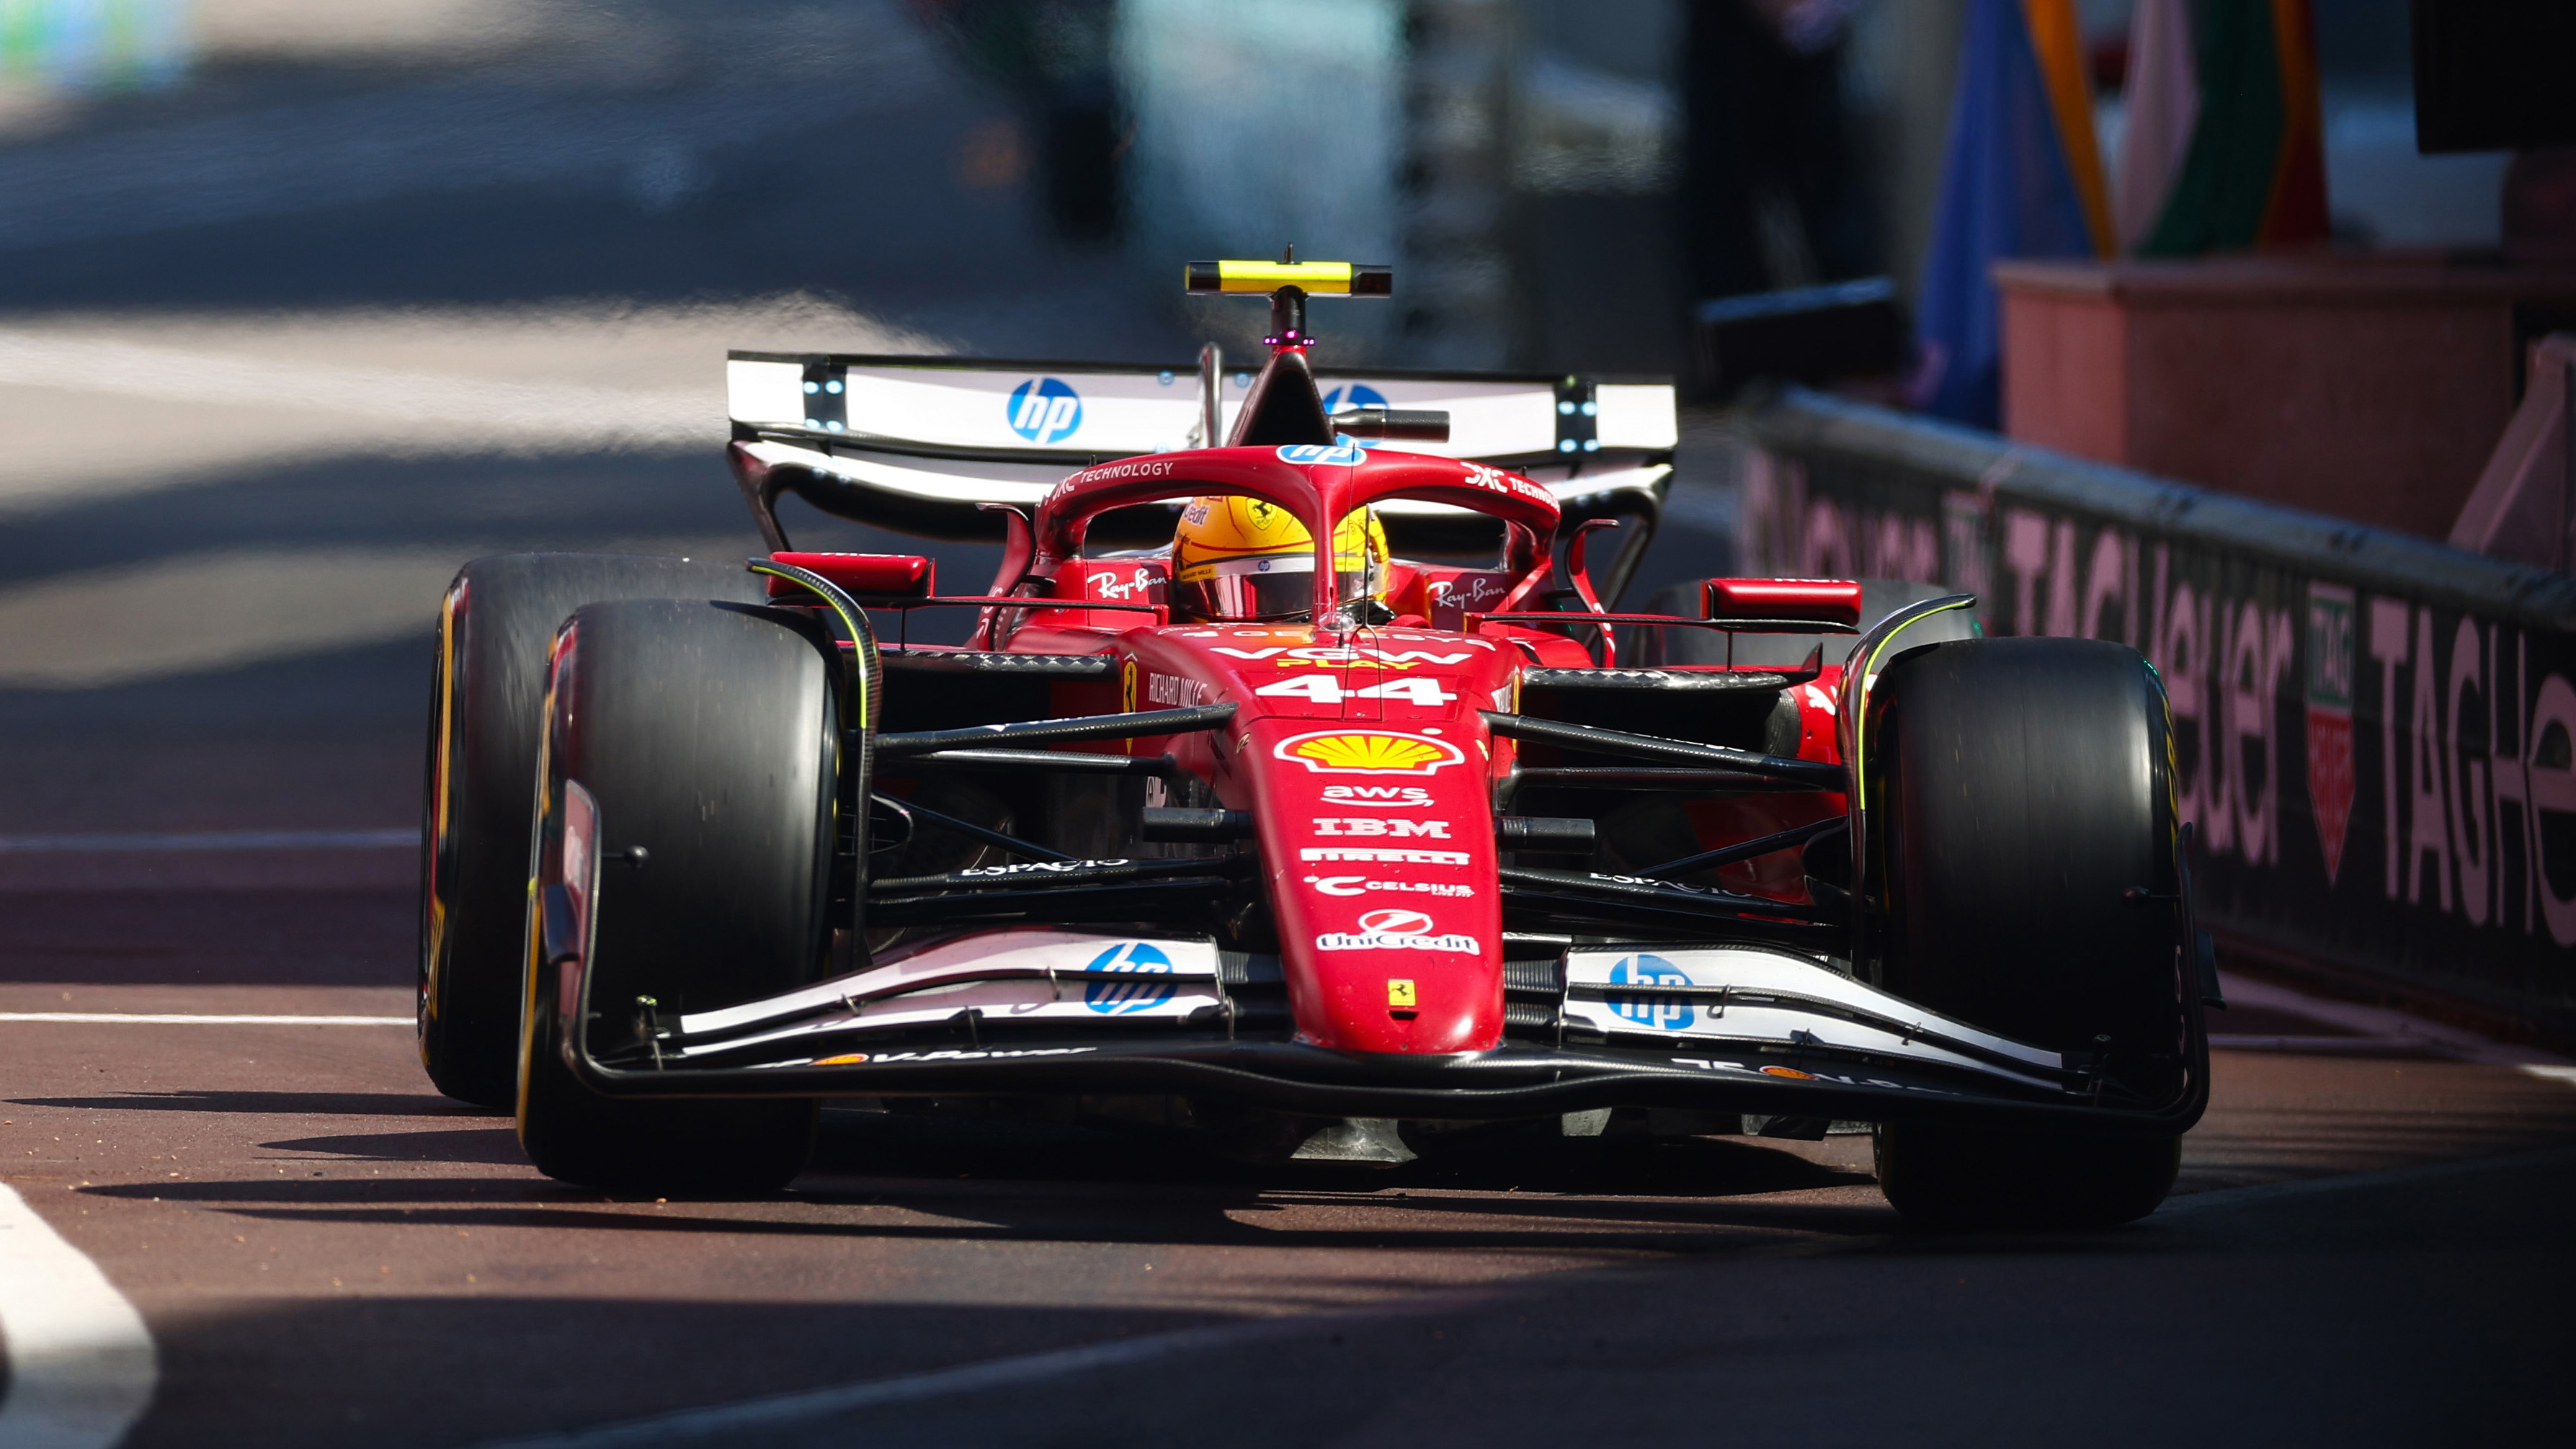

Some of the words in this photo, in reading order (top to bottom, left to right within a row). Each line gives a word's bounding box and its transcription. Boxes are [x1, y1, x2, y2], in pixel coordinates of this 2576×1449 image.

[1011, 375, 1080, 444] hp
[1080, 462, 1174, 483] TECHNOLOGY
[1460, 461, 1508, 494] DXC
[1508, 476, 1561, 512] TECHNOL
[1258, 560, 1270, 571] hp
[1087, 568, 1167, 599] Ray-Ban
[1426, 578, 1505, 609] Ray-Ban
[1208, 647, 1472, 664] VGW
[1276, 659, 1422, 669] PLAY
[1149, 672, 1179, 705] RICHARD
[1178, 677, 1208, 708] MILLE
[1254, 674, 1458, 705] 44
[1322, 785, 1430, 801] aws
[1312, 819, 1452, 839] IBM
[1300, 847, 1471, 865] PIRELLI
[1365, 881, 1473, 895] CELSIUS
[1320, 934, 1475, 952] UniCredit
[1089, 942, 1170, 1016] hp
[1620, 955, 1687, 1030] hp
